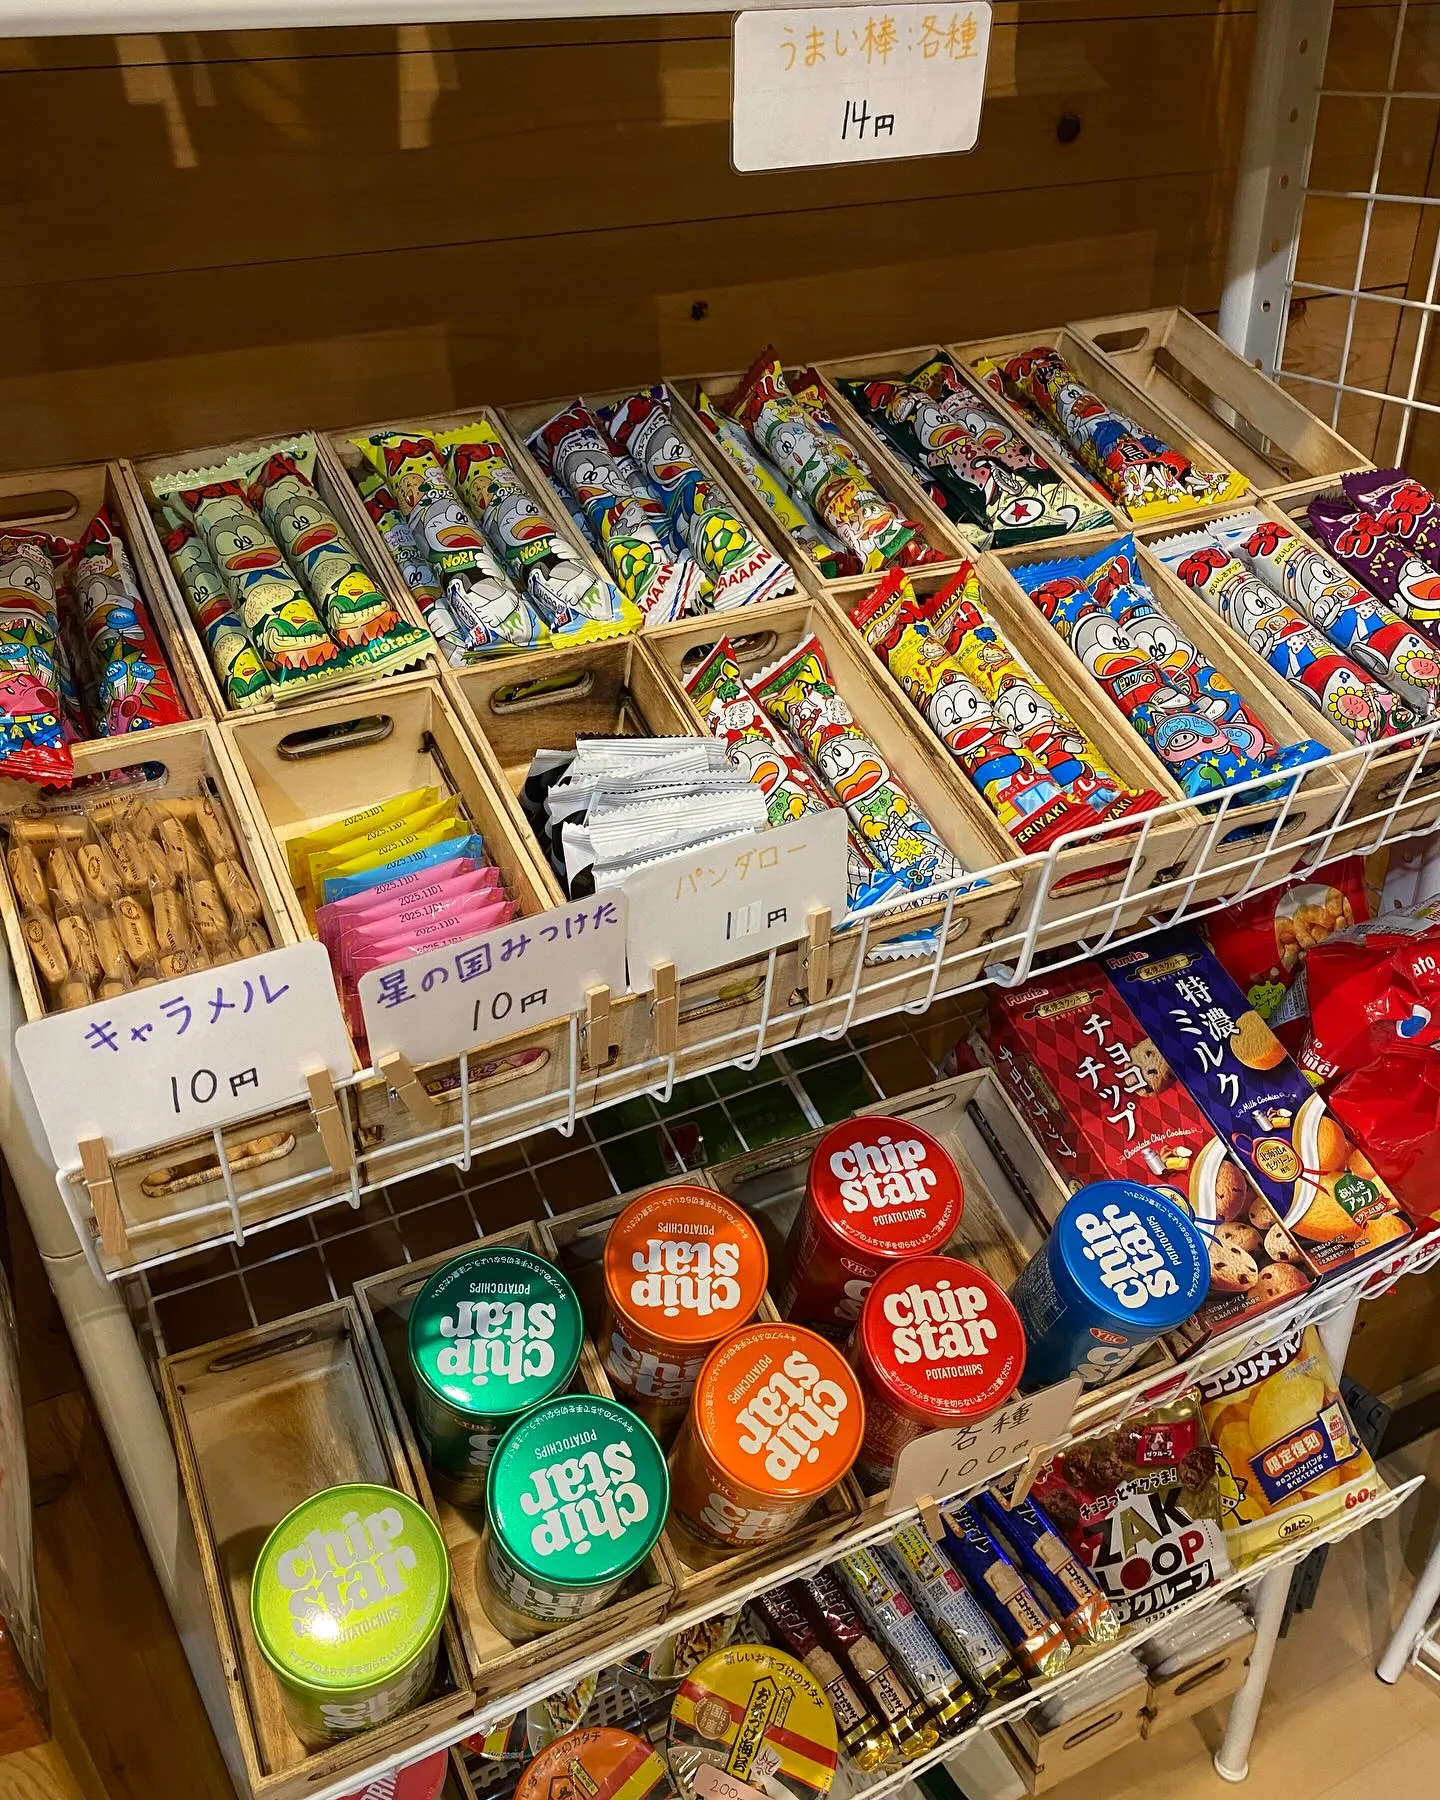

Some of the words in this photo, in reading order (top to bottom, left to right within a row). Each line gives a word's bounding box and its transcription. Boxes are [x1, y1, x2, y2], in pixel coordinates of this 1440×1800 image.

[842, 100, 894, 140] 14円
[442, 552, 474, 569] NORI
[520, 540, 549, 563] NORI
[999, 783, 1020, 801] FAST
[676, 844, 808, 899] パンダロー
[377, 902, 618, 1009] 星の国みつけた
[1106, 951, 1149, 970] Furuta
[84, 975, 289, 1051] キャラメル
[473, 988, 548, 1031] 10円
[1004, 987, 1049, 1006] Furuta
[1082, 1012, 1148, 1095] チョコ
[1168, 1008, 1240, 1108] ミルク
[170, 1068, 259, 1113] 10円
[998, 1043, 1078, 1159] チョコチップ
[1075, 1056, 1137, 1142] チップ
[1242, 1098, 1257, 1114] Milk
[1256, 1091, 1281, 1105] Cookies
[829, 1135, 926, 1181] chip
[1123, 1139, 1151, 1160] Chocolate
[1150, 1132, 1167, 1147] Chip
[1165, 1127, 1192, 1139] Cookies
[840, 1167, 938, 1214] star
[1338, 1180, 1367, 1199] おいしさ
[1343, 1190, 1373, 1211] アップ
[632, 1239, 741, 1280] star
[1075, 1212, 1149, 1309] chip
[1102, 1204, 1180, 1299] star
[630, 1273, 741, 1317] chip
[883, 1279, 988, 1327] chip
[439, 1300, 557, 1344] star
[892, 1318, 998, 1365] star
[1094, 1331, 1124, 1344] YBC
[436, 1338, 555, 1385] chip
[735, 1350, 821, 1455] star
[764, 1379, 848, 1482] chip
[952, 1402, 1033, 1451] 各種
[937, 1439, 1030, 1488] 100円
[1265, 1433, 1321, 1474] 限定復刻
[520, 1440, 637, 1515] star
[1344, 1487, 1377, 1510] 60g
[531, 1482, 649, 1556] chip
[1082, 1486, 1193, 1569] ZAK
[1283, 1517, 1311, 1535] カルビー
[277, 1507, 404, 1591] chip
[288, 1545, 417, 1639] star
[1108, 1560, 1212, 1624] ザクループ
[723, 1651, 825, 1709] 新しいお茶づけのカタチ
